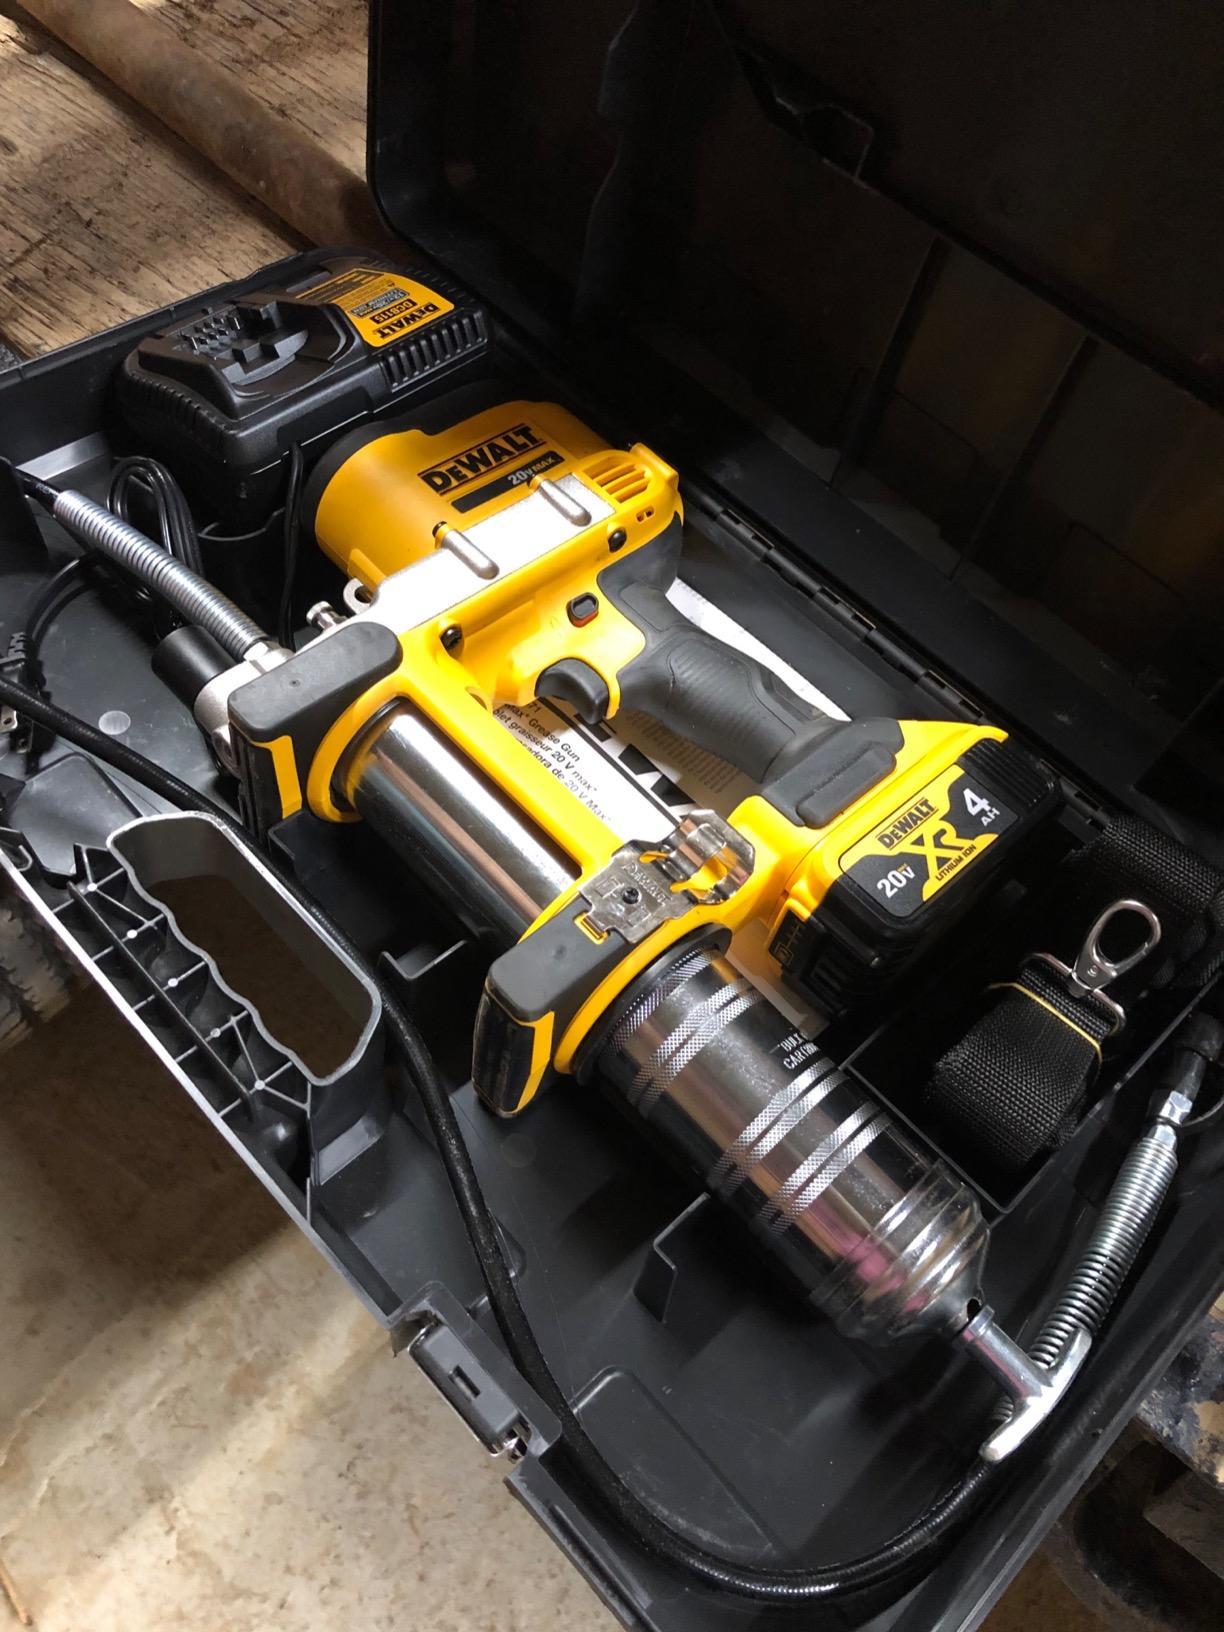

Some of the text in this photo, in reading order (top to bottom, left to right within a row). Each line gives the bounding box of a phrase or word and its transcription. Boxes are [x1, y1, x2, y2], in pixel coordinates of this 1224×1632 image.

[374, 300, 414, 322] DCB115
[420, 425, 543, 494] DEWALT
[528, 701, 541, 712] 71
[493, 709, 511, 723] olet
[508, 722, 552, 752] graisseur
[551, 751, 566, 763] 20
[565, 761, 575, 770] V
[528, 719, 560, 744] Grease
[561, 743, 580, 762] Gun
[552, 768, 565, 780] de
[564, 779, 579, 793] 20
[579, 791, 588, 799] V
[963, 788, 991, 816] 4
[877, 798, 936, 849] DEWALT
[935, 844, 977, 881] LITHIUM ION
